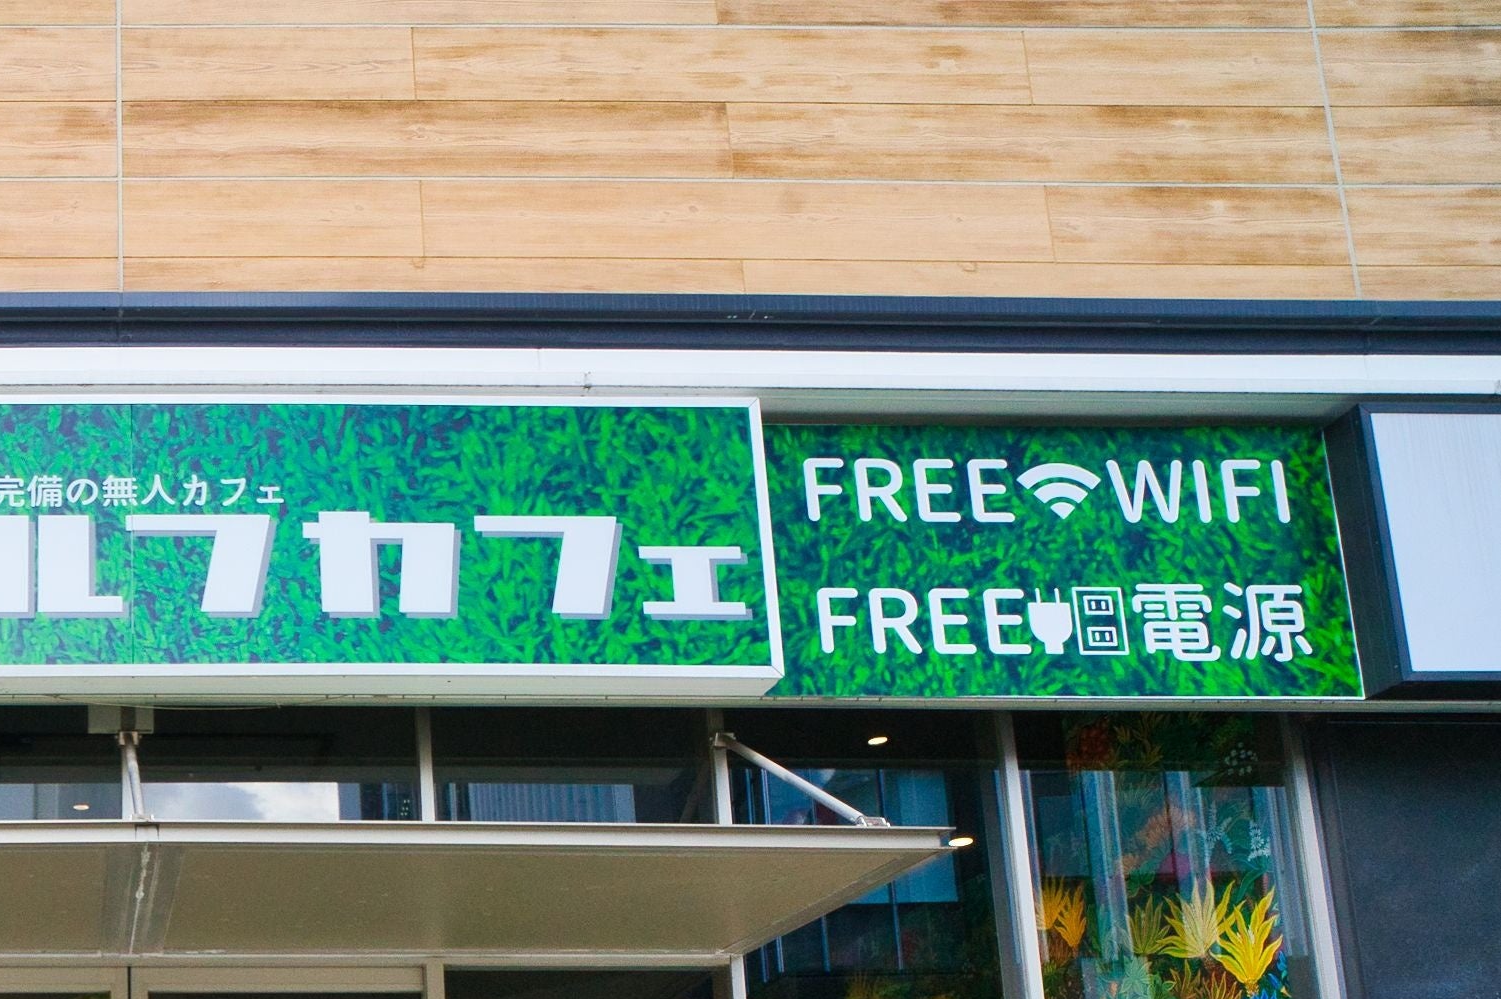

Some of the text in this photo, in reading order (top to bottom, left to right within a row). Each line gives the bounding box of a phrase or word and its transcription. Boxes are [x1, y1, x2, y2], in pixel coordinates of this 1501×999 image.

[802, 457, 1292, 524] FREE WIFI
[815, 581, 1314, 663] FREE 電源
